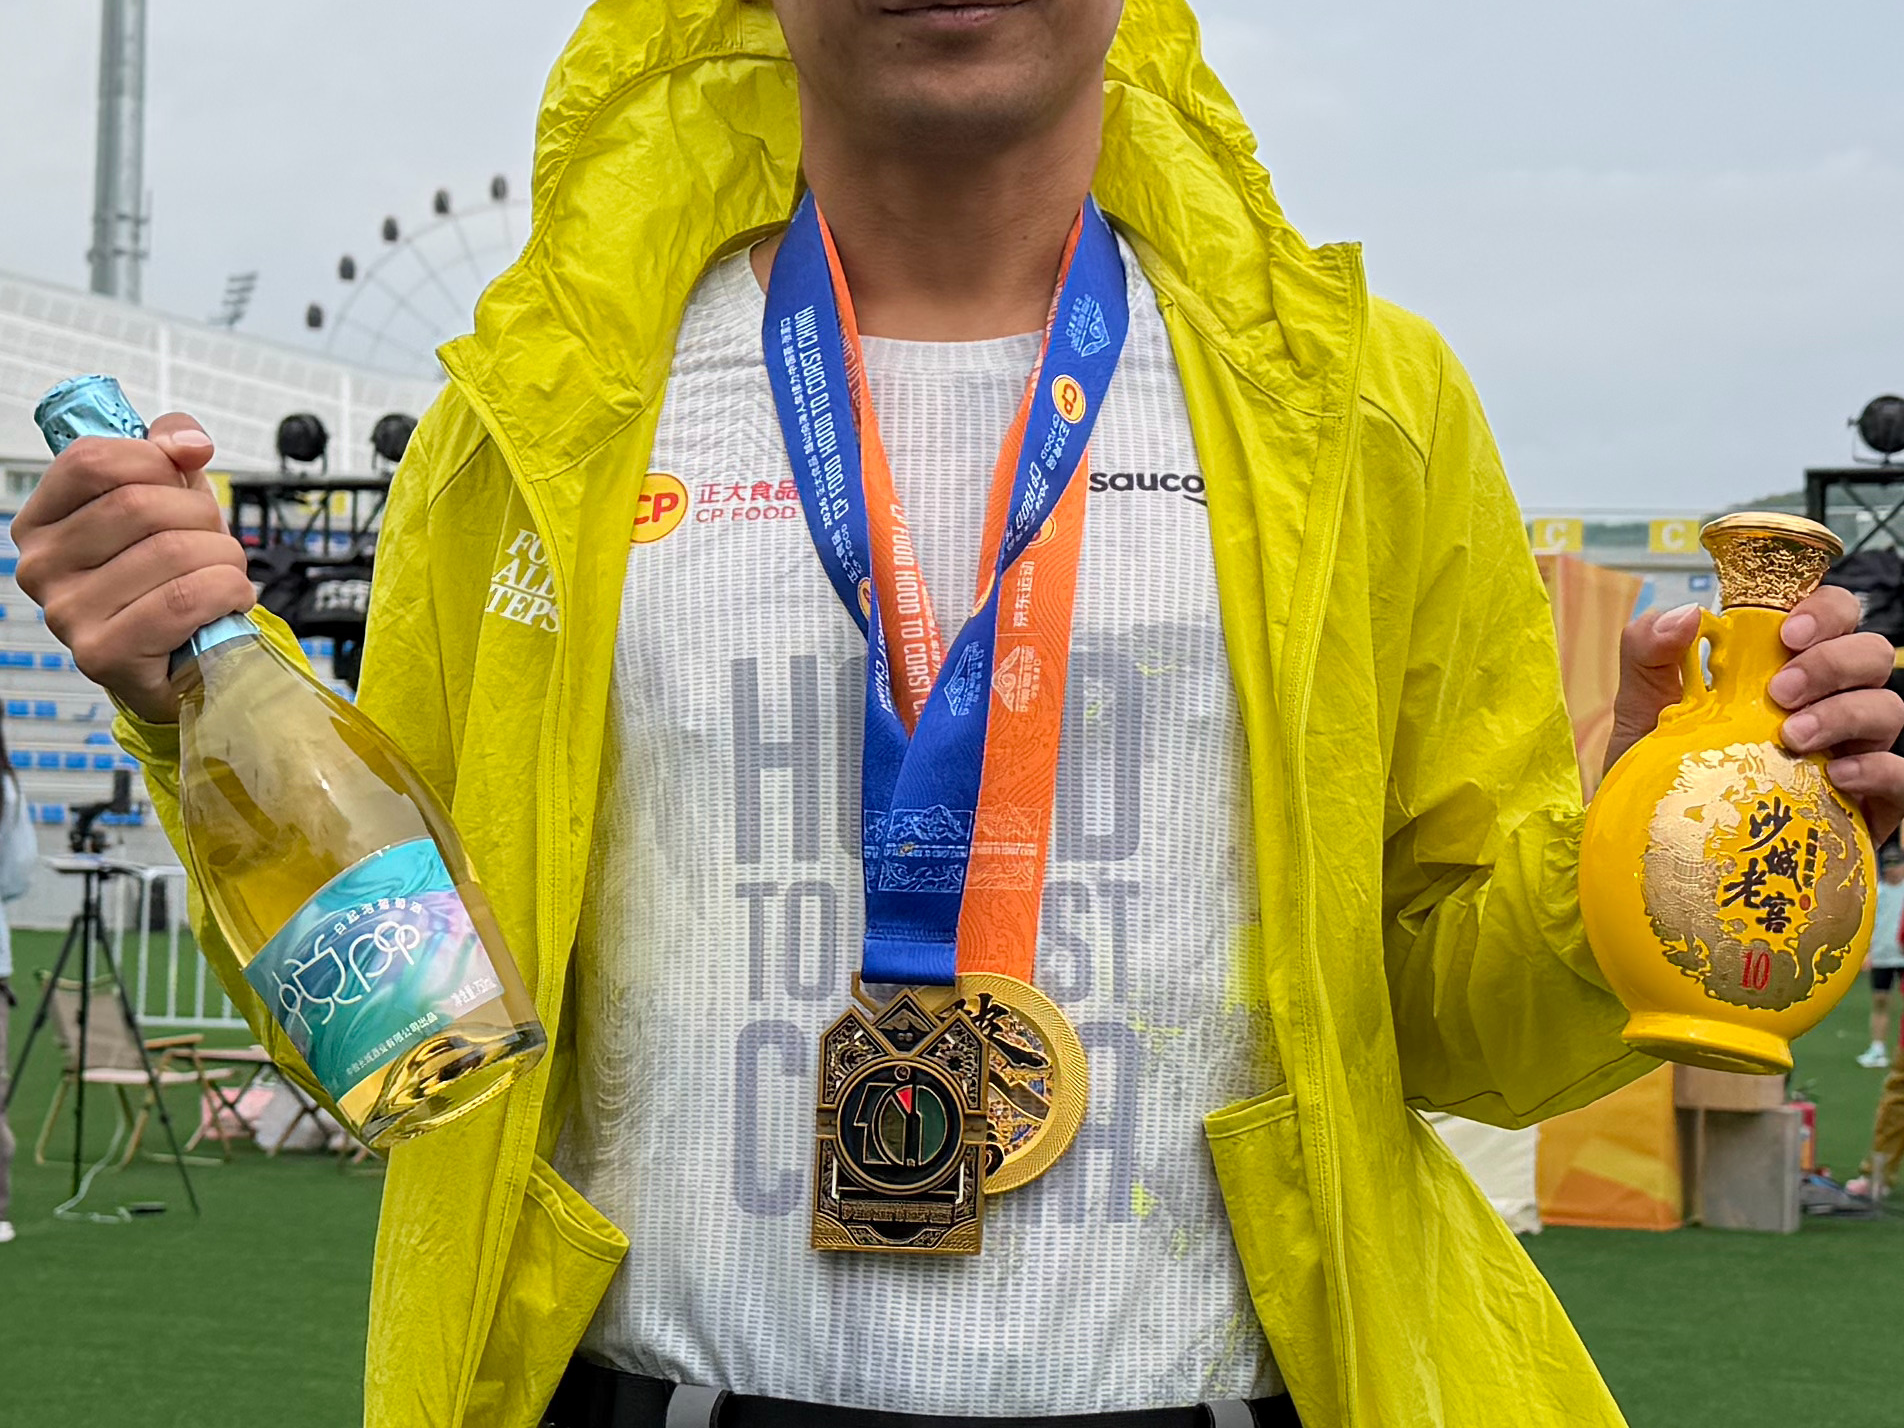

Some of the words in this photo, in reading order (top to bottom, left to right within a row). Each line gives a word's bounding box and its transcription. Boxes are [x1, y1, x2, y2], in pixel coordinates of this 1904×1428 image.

[795, 305, 818, 346] CHINA
[800, 346, 825, 390] COAST
[810, 389, 829, 412] TO
[1062, 383, 1078, 416] CP
[814, 412, 833, 454] HOOD
[698, 480, 799, 504] 正大食品
[824, 454, 845, 496] FOOD
[696, 508, 723, 522] CP
[731, 506, 797, 521] FOOD
[833, 499, 850, 520] CP
[892, 521, 914, 566] FOOD
[1547, 524, 1567, 547] C
[1662, 523, 1685, 549] C
[895, 571, 921, 615] HOOD
[1013, 561, 1035, 628] 京东运动
[900, 619, 924, 639] TO
[904, 643, 932, 694] COAST
[735, 882, 838, 1001] TO
[1741, 949, 1772, 991] 10
